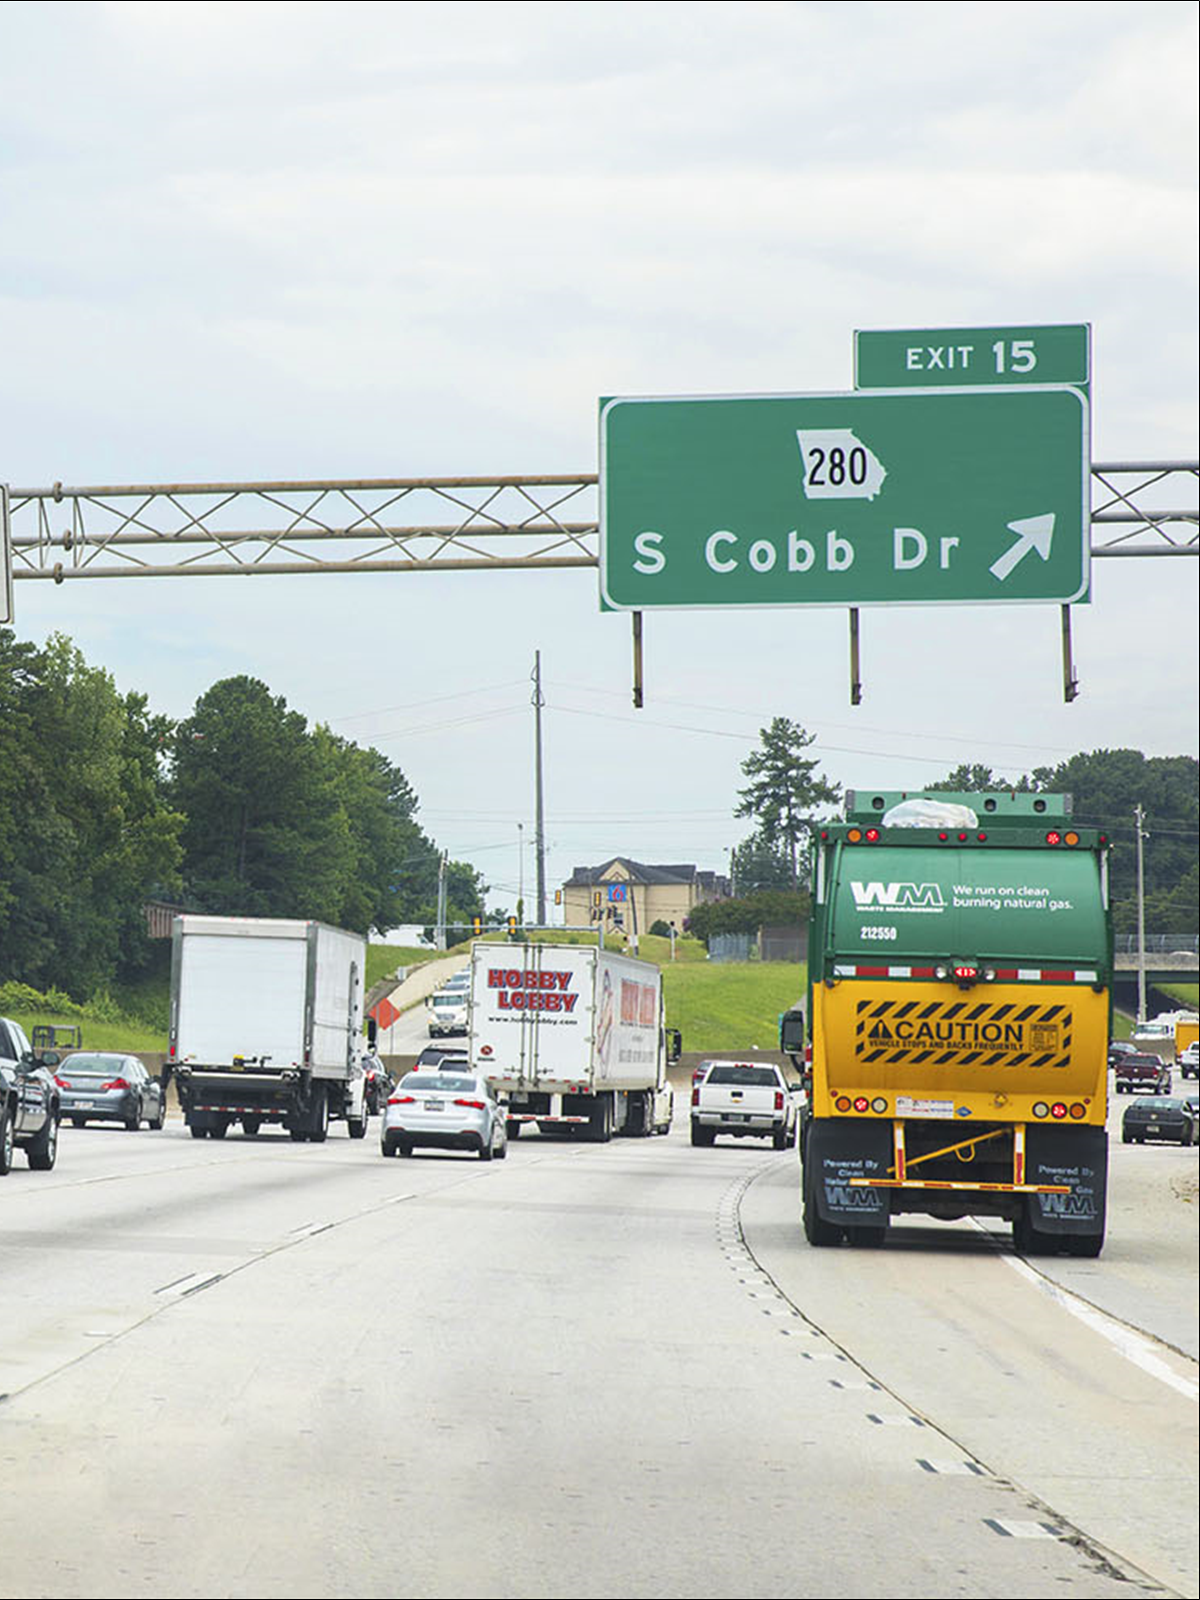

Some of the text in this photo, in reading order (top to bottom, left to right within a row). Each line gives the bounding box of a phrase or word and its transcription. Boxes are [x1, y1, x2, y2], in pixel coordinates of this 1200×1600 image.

[907, 340, 1038, 374] EXIT 15
[807, 447, 868, 486] 280
[632, 528, 960, 575] S Cobb Dr
[612, 884, 624, 902] 6
[850, 882, 945, 906] WM
[952, 885, 1050, 896] We run on clean
[953, 897, 1074, 911] burning natural gas.
[860, 926, 897, 941] 212550
[487, 968, 574, 991] HOBBY
[497, 991, 579, 1013] LOBBY
[895, 1021, 1023, 1042] CAUTION
[869, 1040, 900, 1048] VEHICLE
[929, 1041, 945, 1049] AND
[947, 1042, 972, 1050] BACKS
[974, 1043, 1024, 1051] FREQUENTLY
[823, 1160, 879, 1170] Powered By
[838, 1169, 864, 1177] Clean
[1039, 1165, 1094, 1178] Powered By
